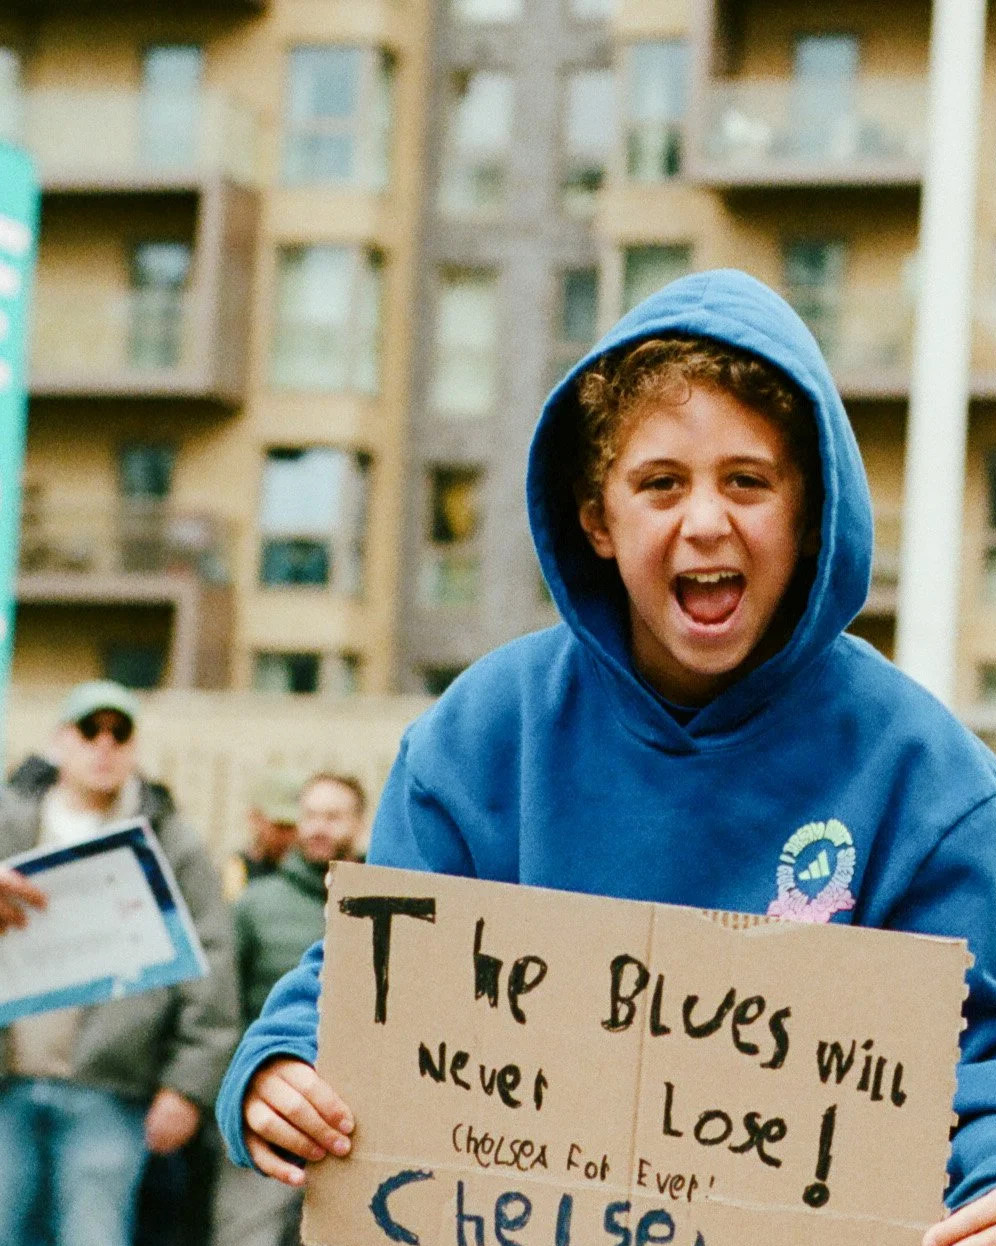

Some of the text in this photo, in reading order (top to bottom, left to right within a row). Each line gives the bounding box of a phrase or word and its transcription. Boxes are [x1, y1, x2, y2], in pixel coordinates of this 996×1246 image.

[338, 896, 548, 1025] The
[418, 1041, 548, 1111] Never
[567, 1143, 609, 1181] For
